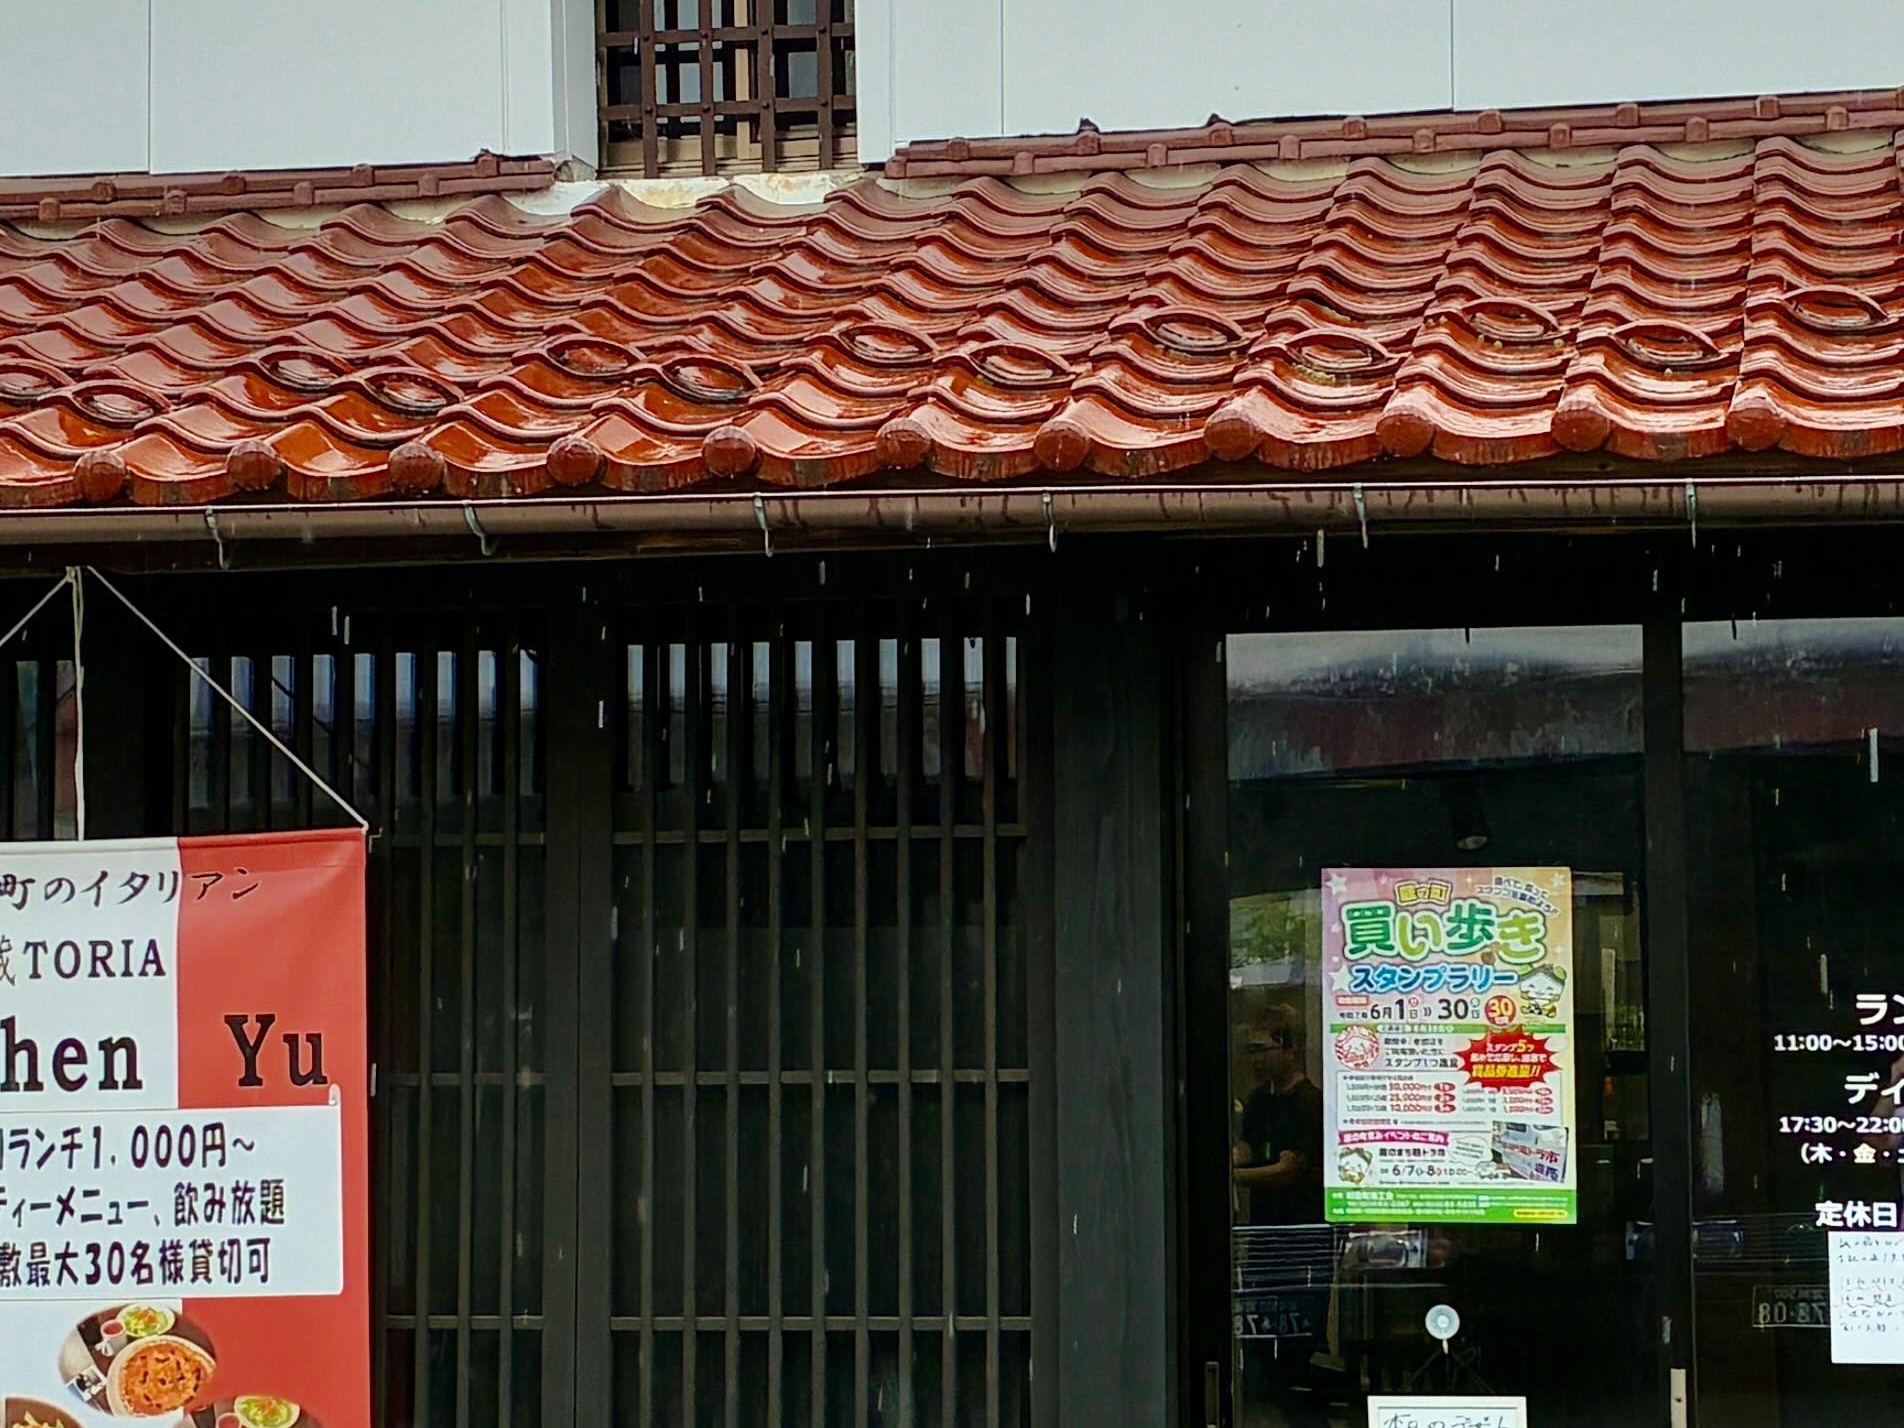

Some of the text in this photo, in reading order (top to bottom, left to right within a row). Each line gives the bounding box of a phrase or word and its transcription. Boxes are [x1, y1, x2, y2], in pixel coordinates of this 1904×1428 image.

[1344, 901, 1545, 964] 買い歩き
[1350, 965, 1520, 994] スタンプラリー
[223, 1013, 329, 1089] Yu
